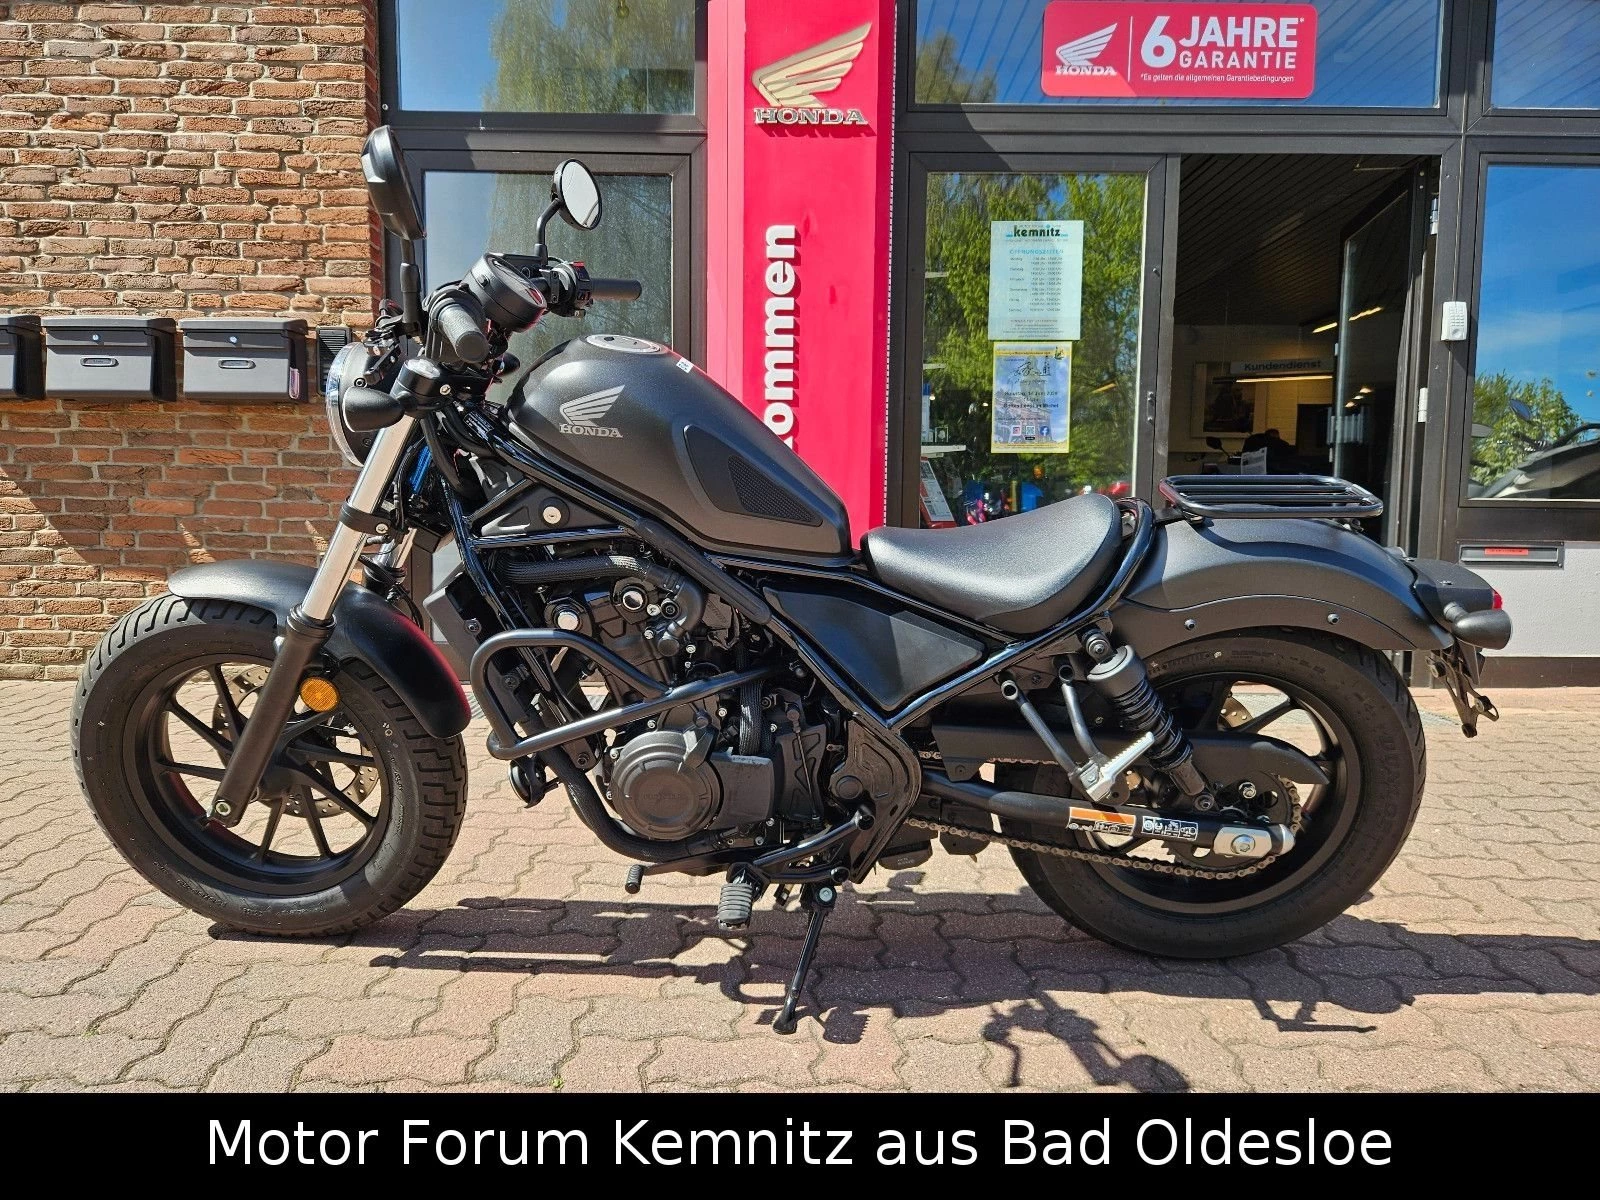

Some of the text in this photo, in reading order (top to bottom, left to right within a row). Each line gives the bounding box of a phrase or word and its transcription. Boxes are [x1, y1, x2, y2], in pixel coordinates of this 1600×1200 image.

[1140, 15, 1177, 69] 6
[1179, 50, 1297, 69] GARANTIE
[1055, 64, 1118, 76] HONDA
[1152, 73, 1173, 82] gelten
[1174, 73, 1185, 81] die
[1186, 73, 1225, 83] allgemeinen
[1226, 74, 1295, 83] Garantiebedingungen
[754, 107, 869, 126] HONDA
[1013, 225, 1061, 238] kemnitz
[762, 224, 797, 450] ommen
[1244, 360, 1321, 372] Kundendienst
[558, 422, 624, 439] HONDA
